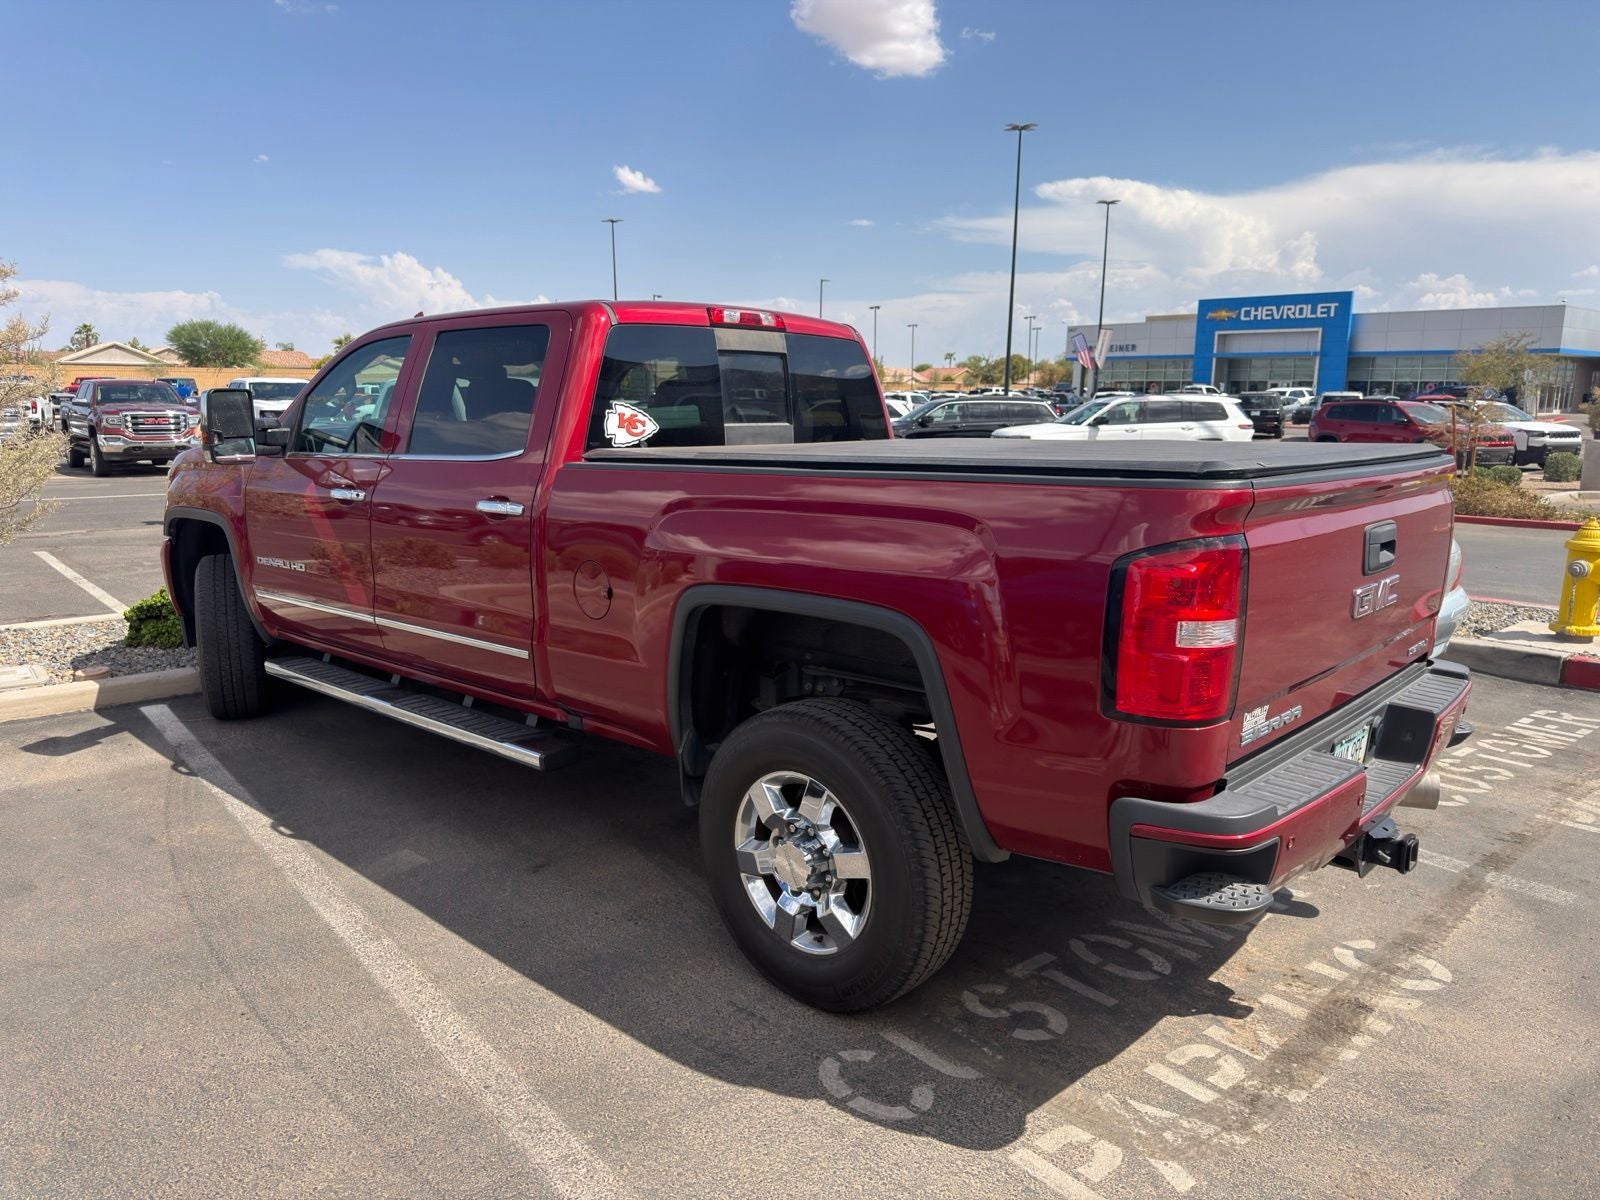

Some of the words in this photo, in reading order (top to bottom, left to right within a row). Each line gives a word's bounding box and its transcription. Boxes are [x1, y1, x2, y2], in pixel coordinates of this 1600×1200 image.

[1240, 303, 1338, 321] CHEVROLET
[1107, 343, 1137, 353] EINER
[617, 412, 646, 437] KC
[256, 556, 290, 569] DENALI
[290, 560, 305, 571] HD
[1352, 574, 1400, 619] GMC
[1240, 704, 1302, 748] SIERRA
